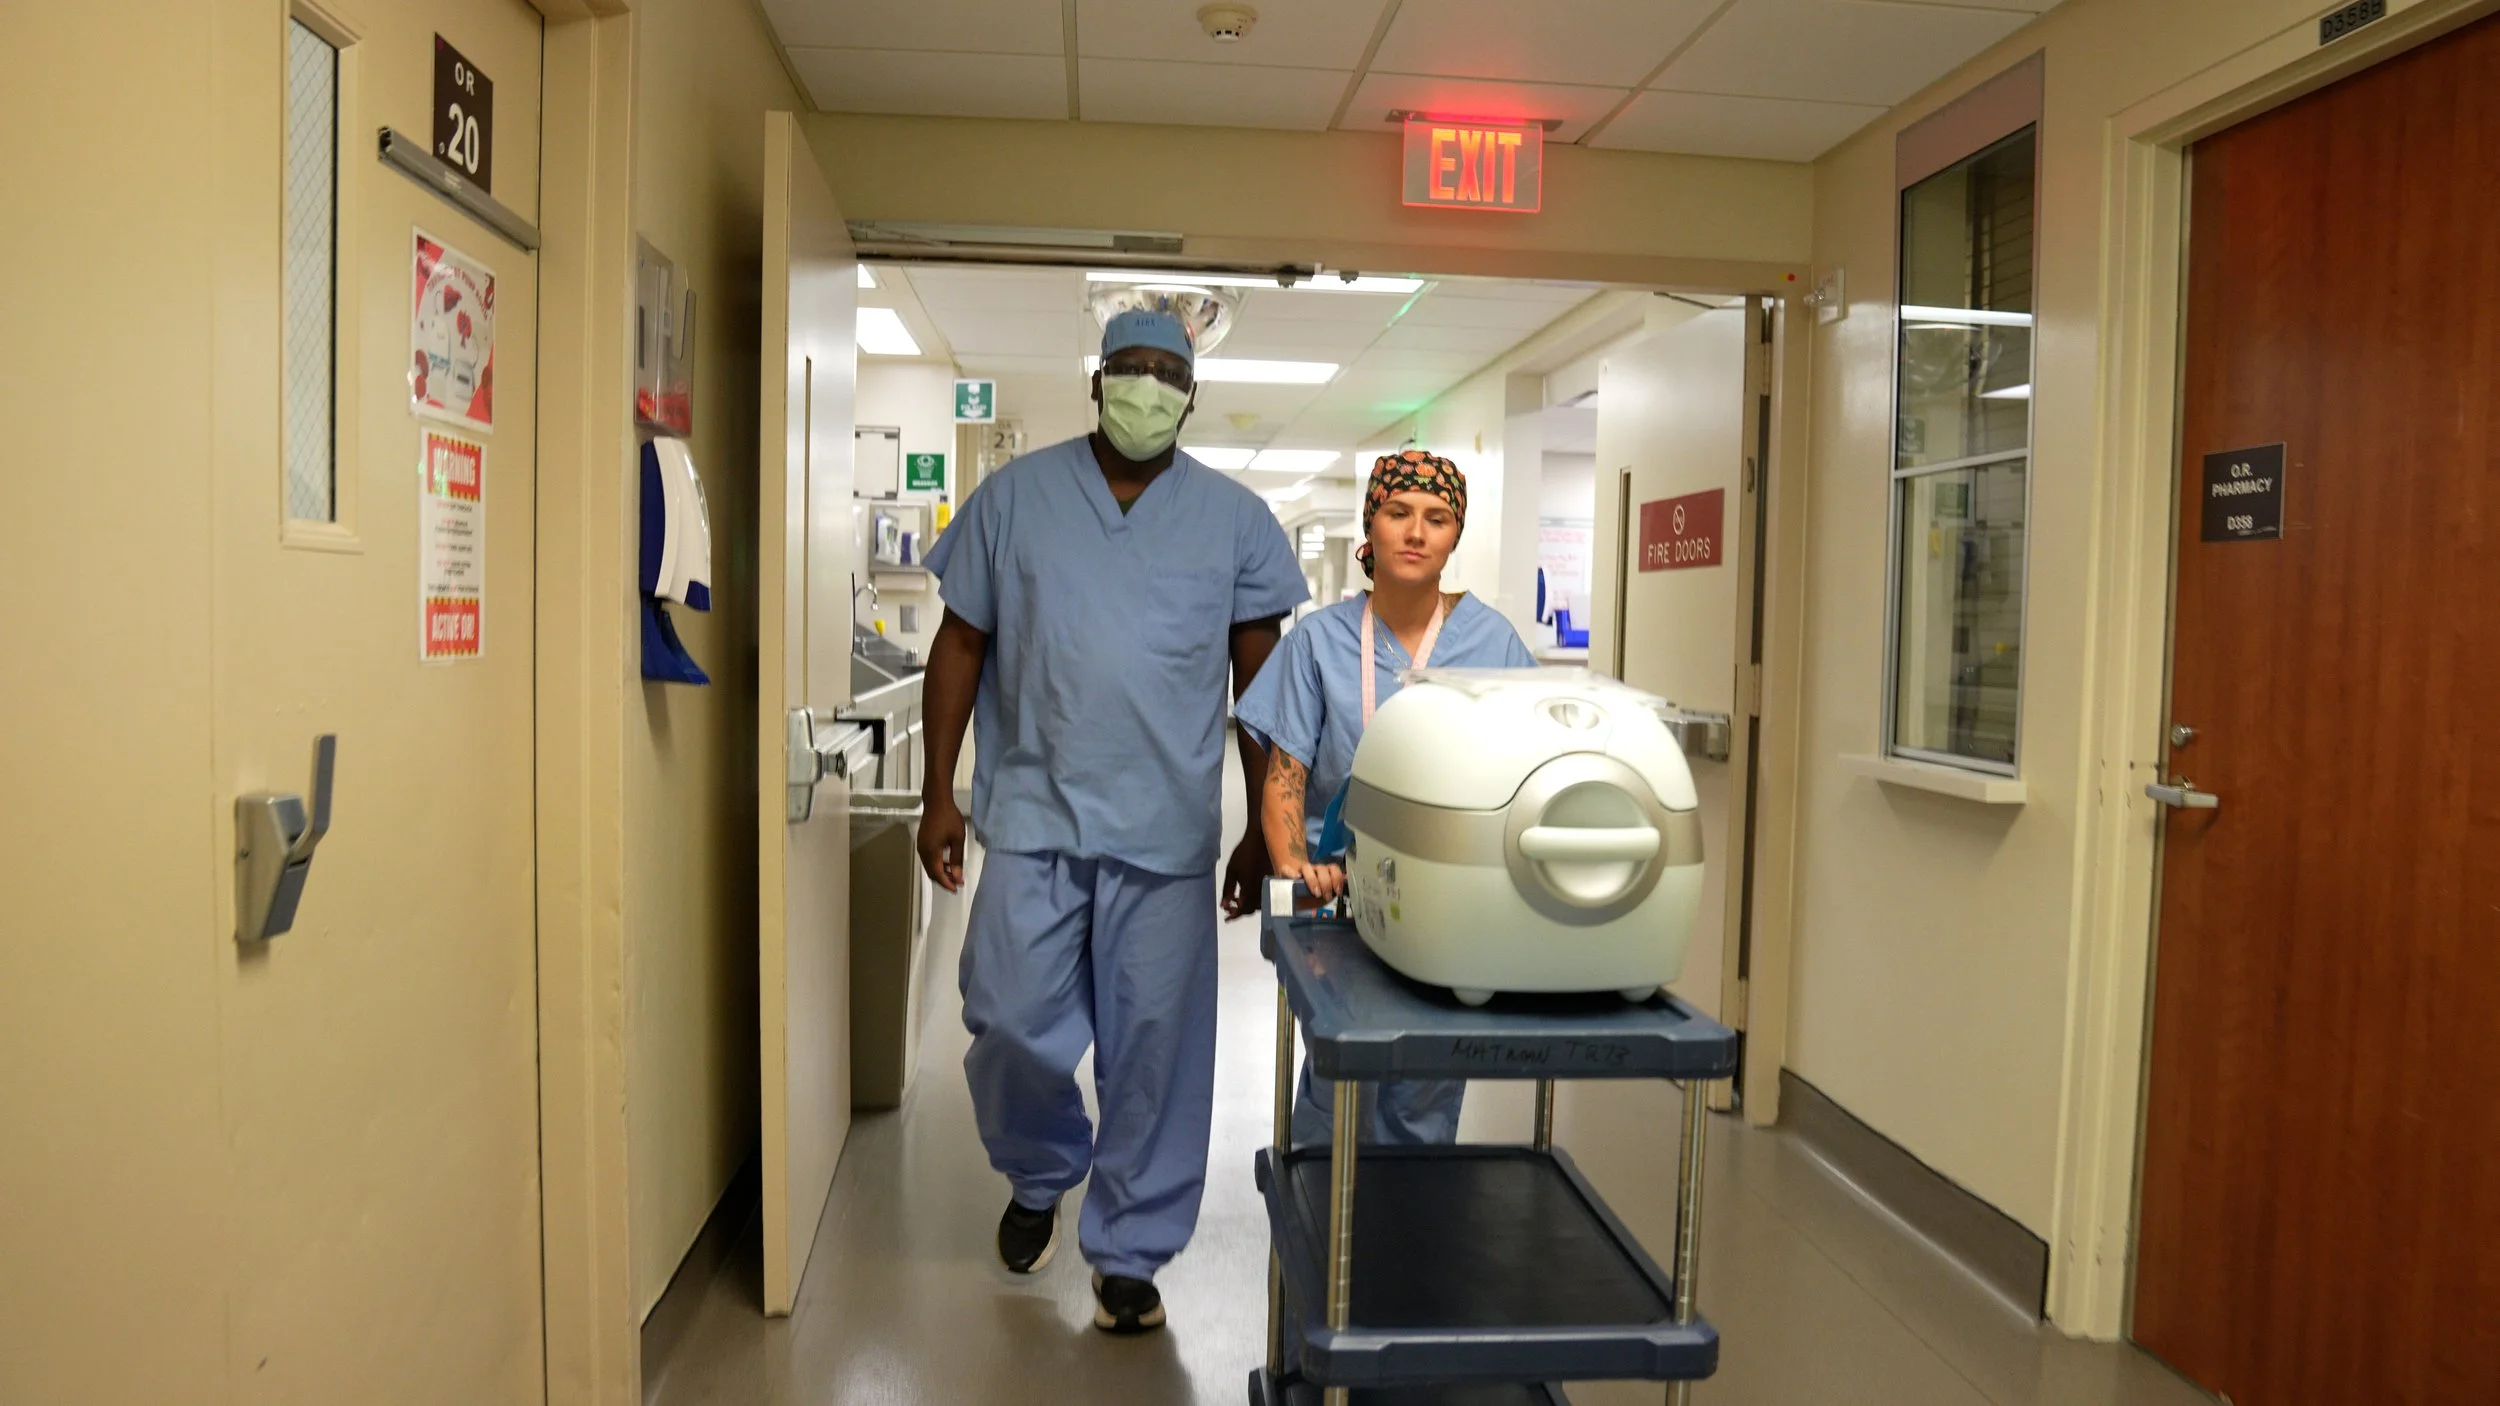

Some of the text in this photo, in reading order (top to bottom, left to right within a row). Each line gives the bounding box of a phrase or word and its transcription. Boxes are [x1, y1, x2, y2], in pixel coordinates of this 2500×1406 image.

[455, 61, 475, 96] OR
[447, 102, 480, 174] 20
[1429, 128, 1522, 204] EXIT
[994, 431, 1016, 449] 21
[432, 446, 477, 488] WARNING
[2211, 476, 2273, 498] PHARMACY
[1647, 536, 1712, 565] FIRE DOORS
[431, 612, 460, 642] ACTIVE
